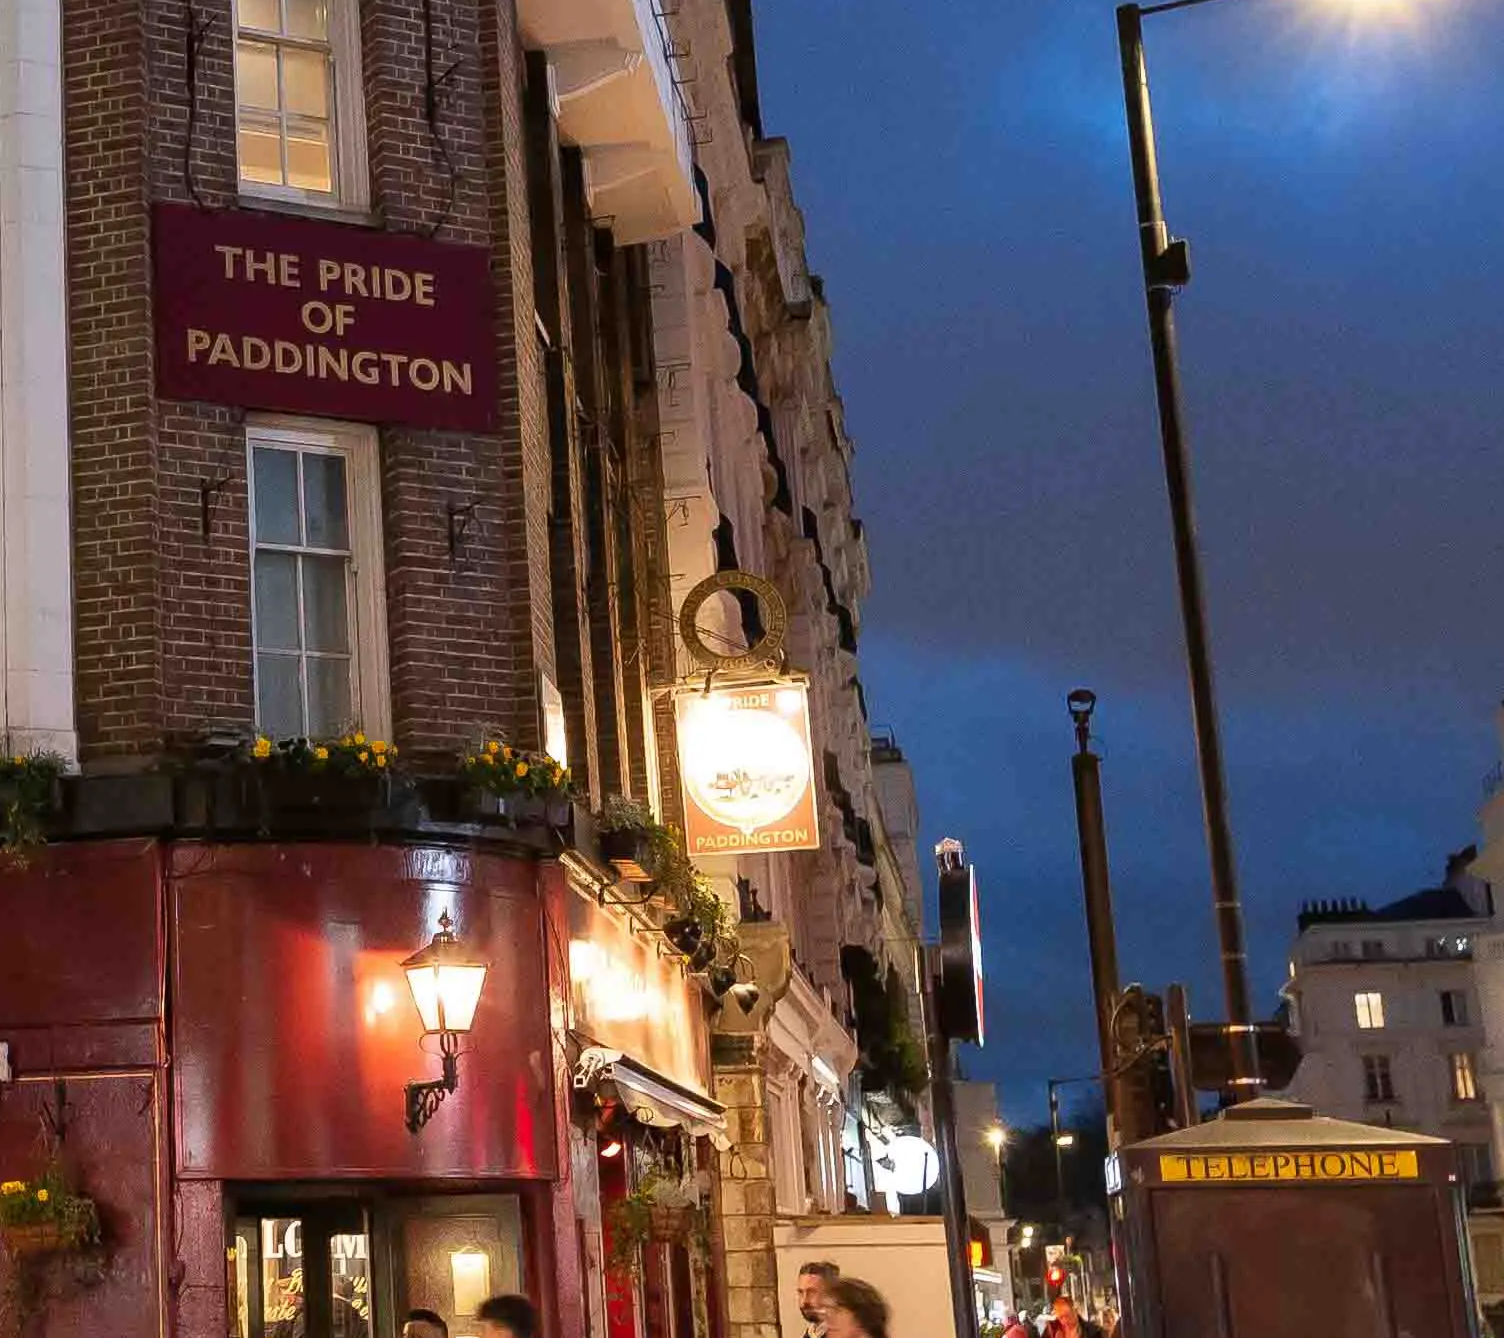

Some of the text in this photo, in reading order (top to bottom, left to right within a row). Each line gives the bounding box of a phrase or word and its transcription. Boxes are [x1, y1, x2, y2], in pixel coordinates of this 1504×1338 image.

[215, 245, 436, 308] THE PRIDE
[301, 300, 356, 336] OF
[187, 327, 474, 396] PADDINGTON
[728, 692, 770, 711] RIDE
[695, 829, 809, 851] PADDINGTON
[1176, 1153, 1400, 1180] TELEPHONE
